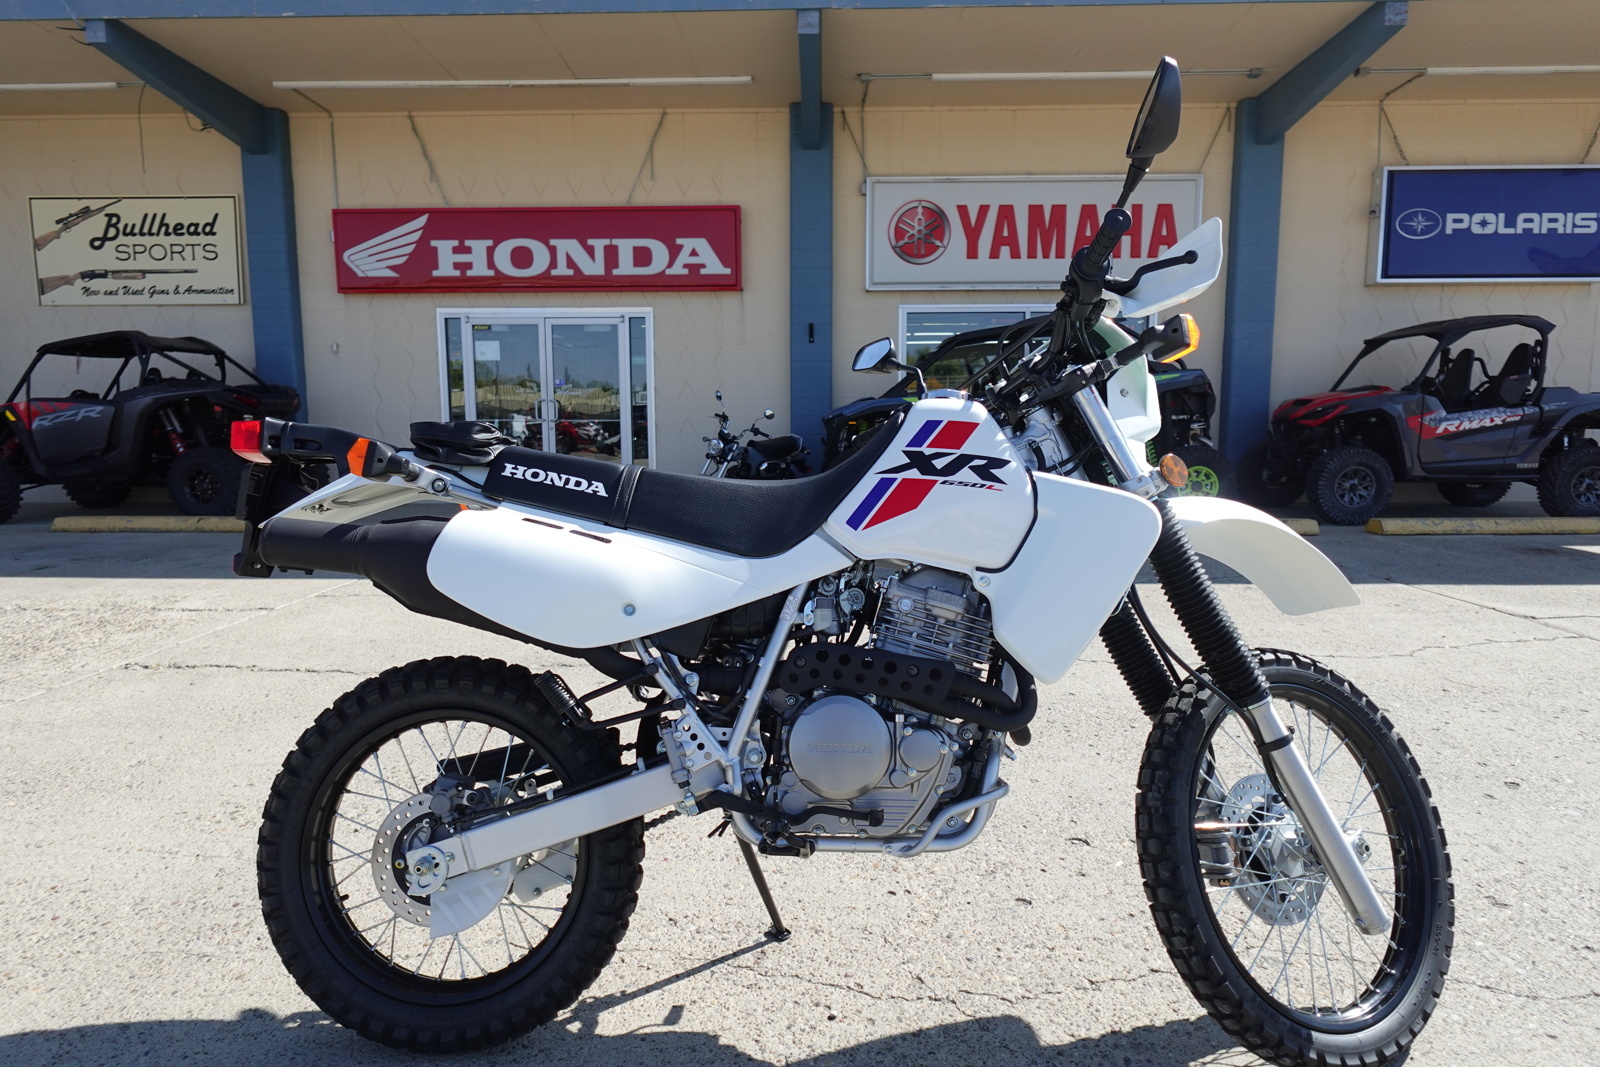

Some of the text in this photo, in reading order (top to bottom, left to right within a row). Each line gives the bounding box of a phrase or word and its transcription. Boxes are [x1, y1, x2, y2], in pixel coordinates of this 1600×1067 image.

[89, 212, 219, 250] Bullhead
[956, 203, 1179, 259] YAMAHA
[1445, 212, 1598, 235] POLARIS
[115, 243, 219, 261] SPORTS
[430, 237, 732, 277] HONDA
[81, 285, 235, 298] New and Used Guns & Ammunition
[31, 405, 105, 430] RZR
[1435, 414, 1509, 434] RMAX
[873, 450, 1012, 485] XR
[501, 463, 609, 497] HONDA
[940, 479, 1003, 491] 650L
[808, 743, 873, 753] HONDA
